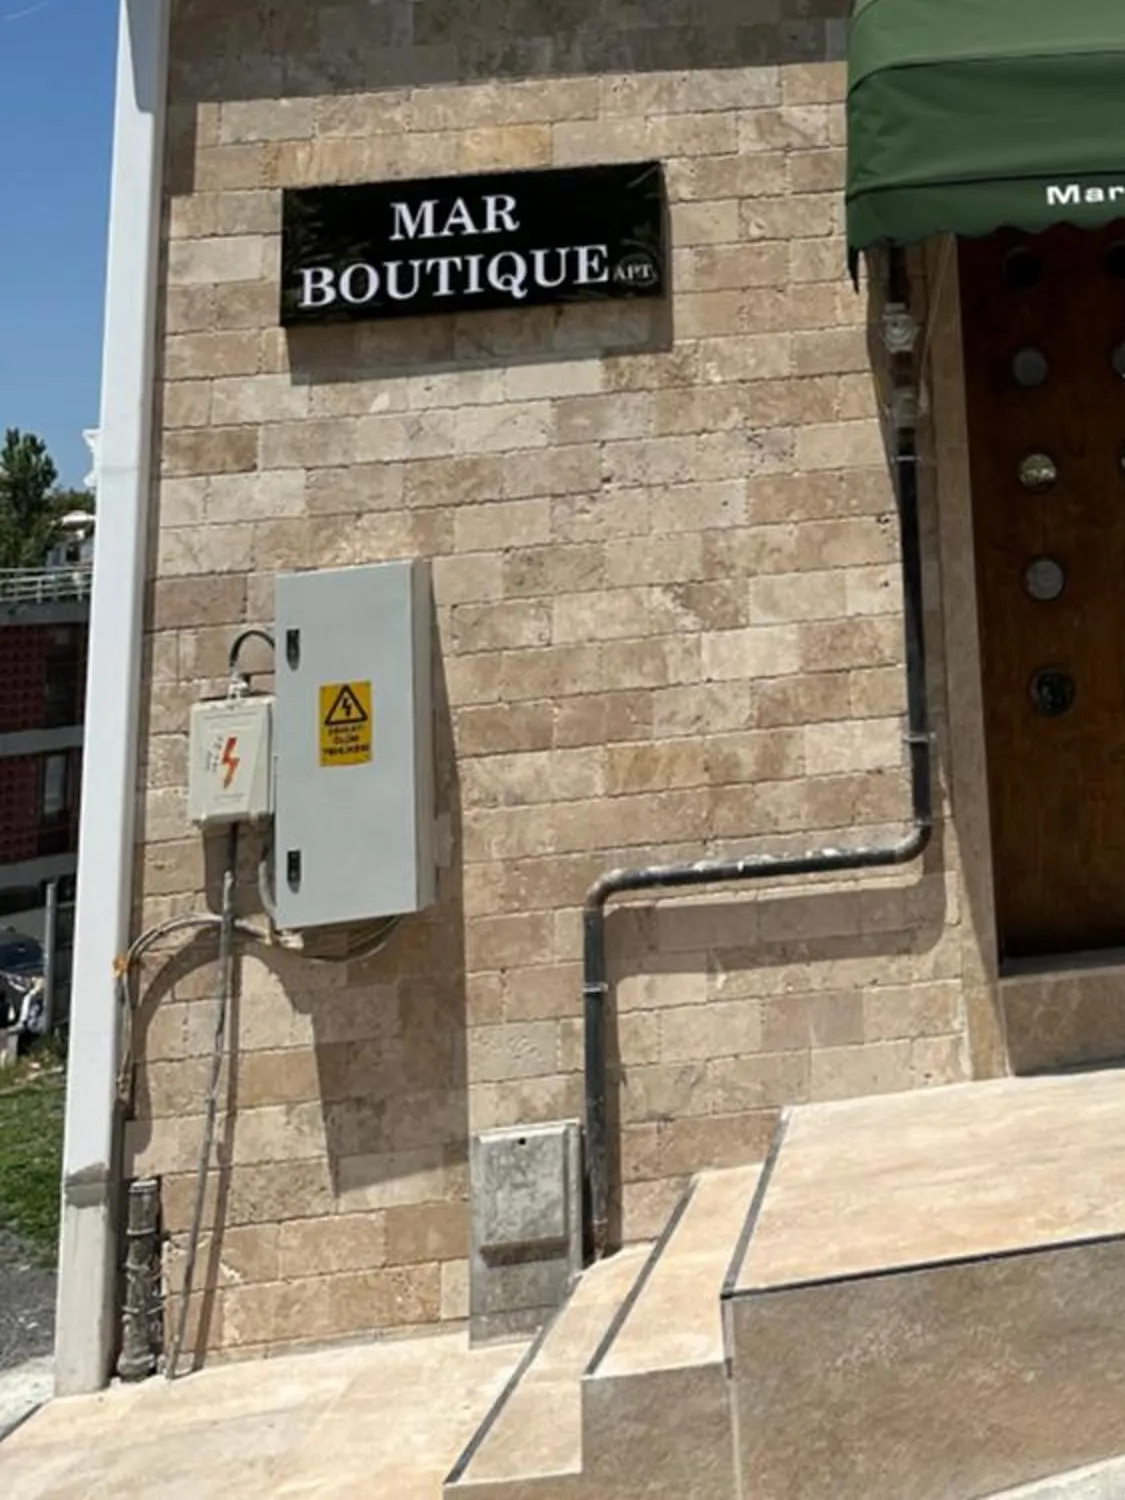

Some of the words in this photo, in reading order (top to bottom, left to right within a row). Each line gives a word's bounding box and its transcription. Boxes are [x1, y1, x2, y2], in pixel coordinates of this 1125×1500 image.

[389, 194, 520, 241] MAR
[1046, 184, 1125, 205] Mar
[299, 244, 609, 308] BOUTIQUE
